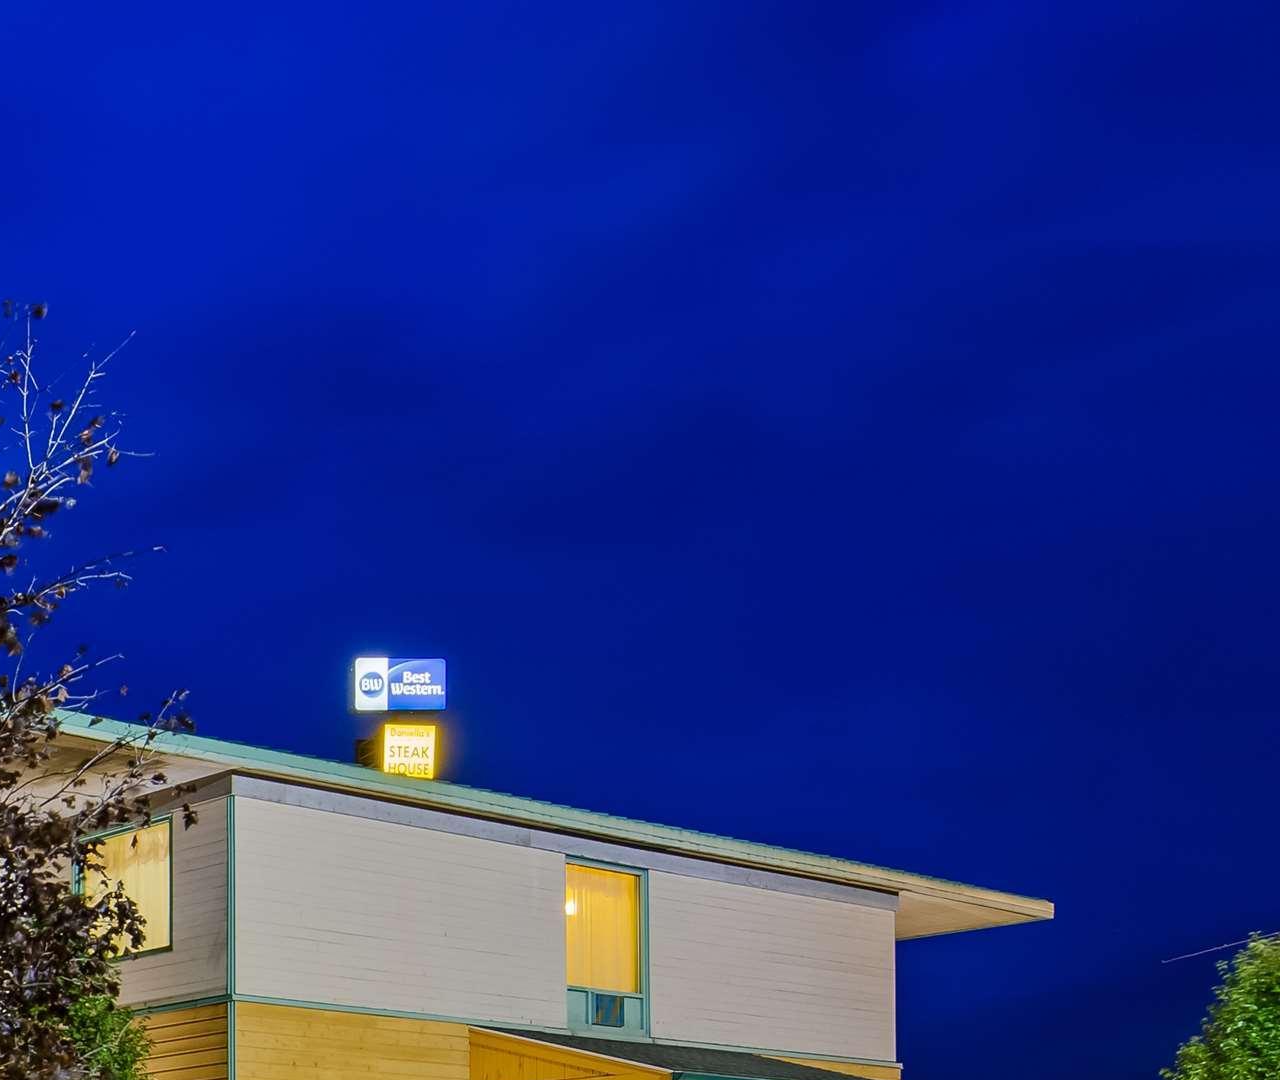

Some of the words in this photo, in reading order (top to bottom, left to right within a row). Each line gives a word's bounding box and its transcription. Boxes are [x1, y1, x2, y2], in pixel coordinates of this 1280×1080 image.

[403, 671, 431, 683] Best
[361, 679, 382, 691] BW
[389, 745, 429, 758] STEAK
[388, 762, 430, 775] HOUSE
